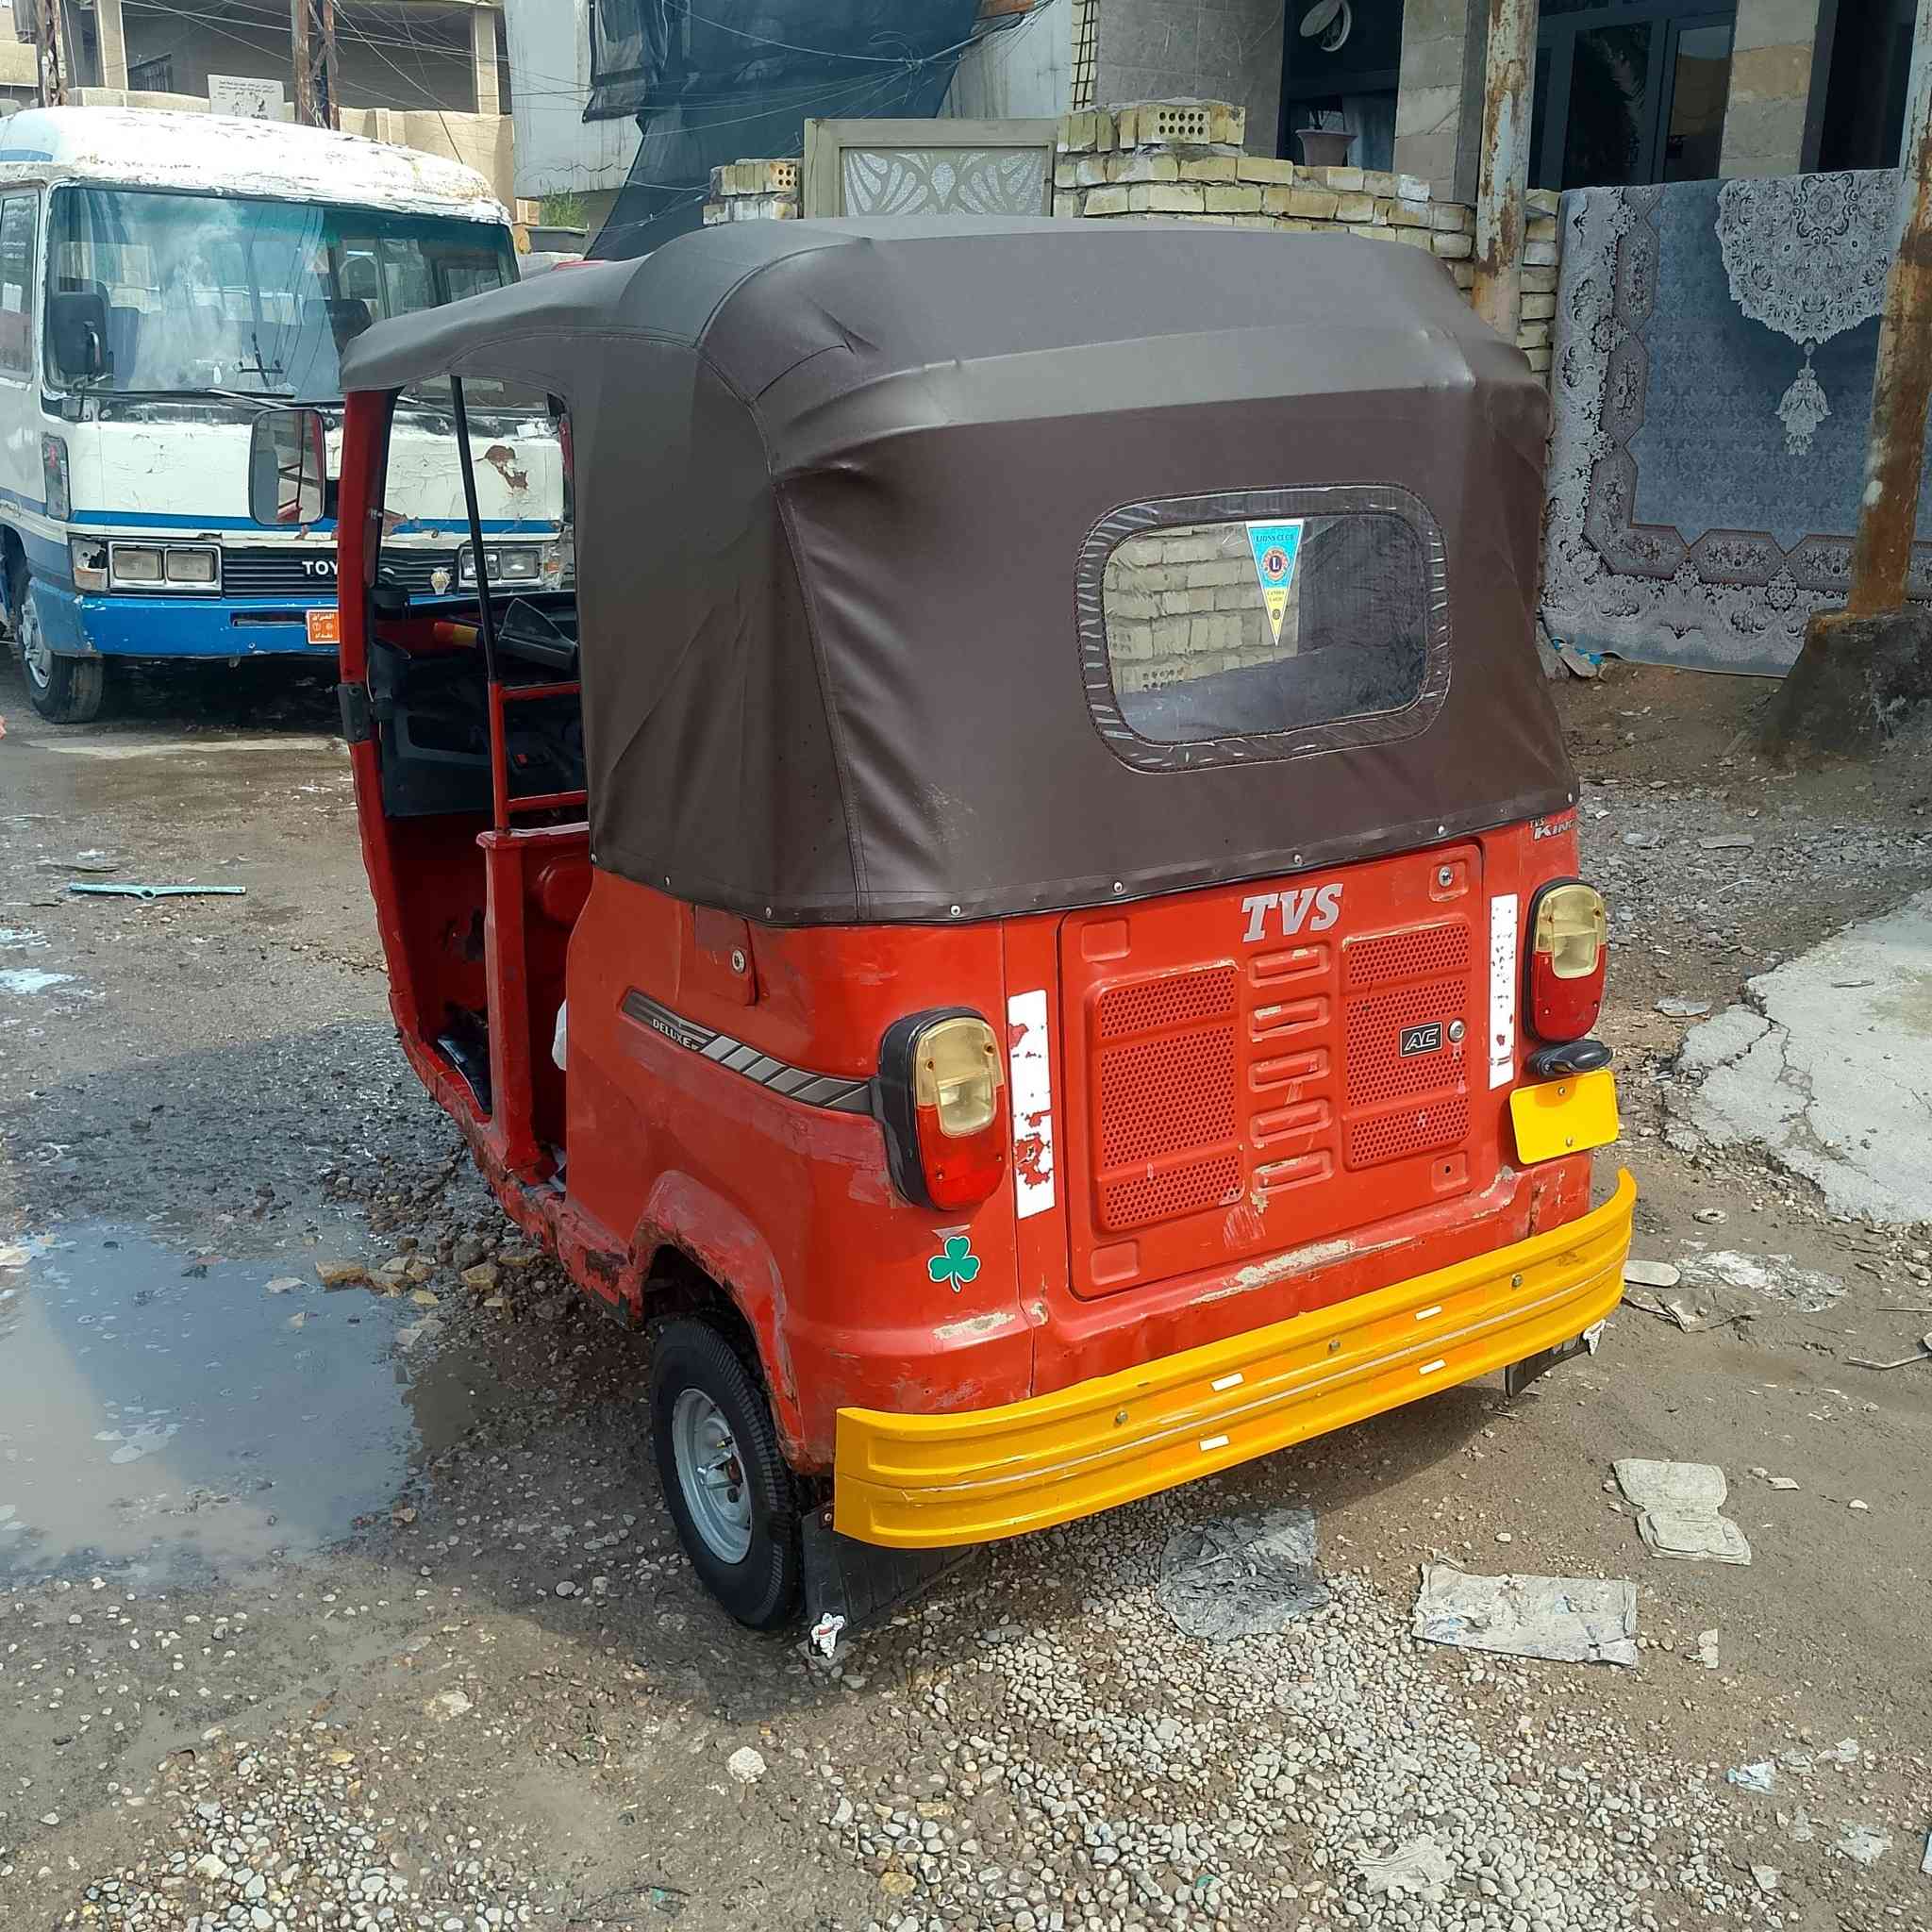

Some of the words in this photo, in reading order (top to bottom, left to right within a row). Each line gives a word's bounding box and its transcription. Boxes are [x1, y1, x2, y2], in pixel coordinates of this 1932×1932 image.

[302, 560, 339, 575] TOY
[1272, 557, 1280, 570] L
[1529, 816, 1547, 828] TVS
[1241, 883, 1343, 942] TVS
[652, 1019, 691, 1048] DELUXE
[1403, 1027, 1439, 1051] AC
